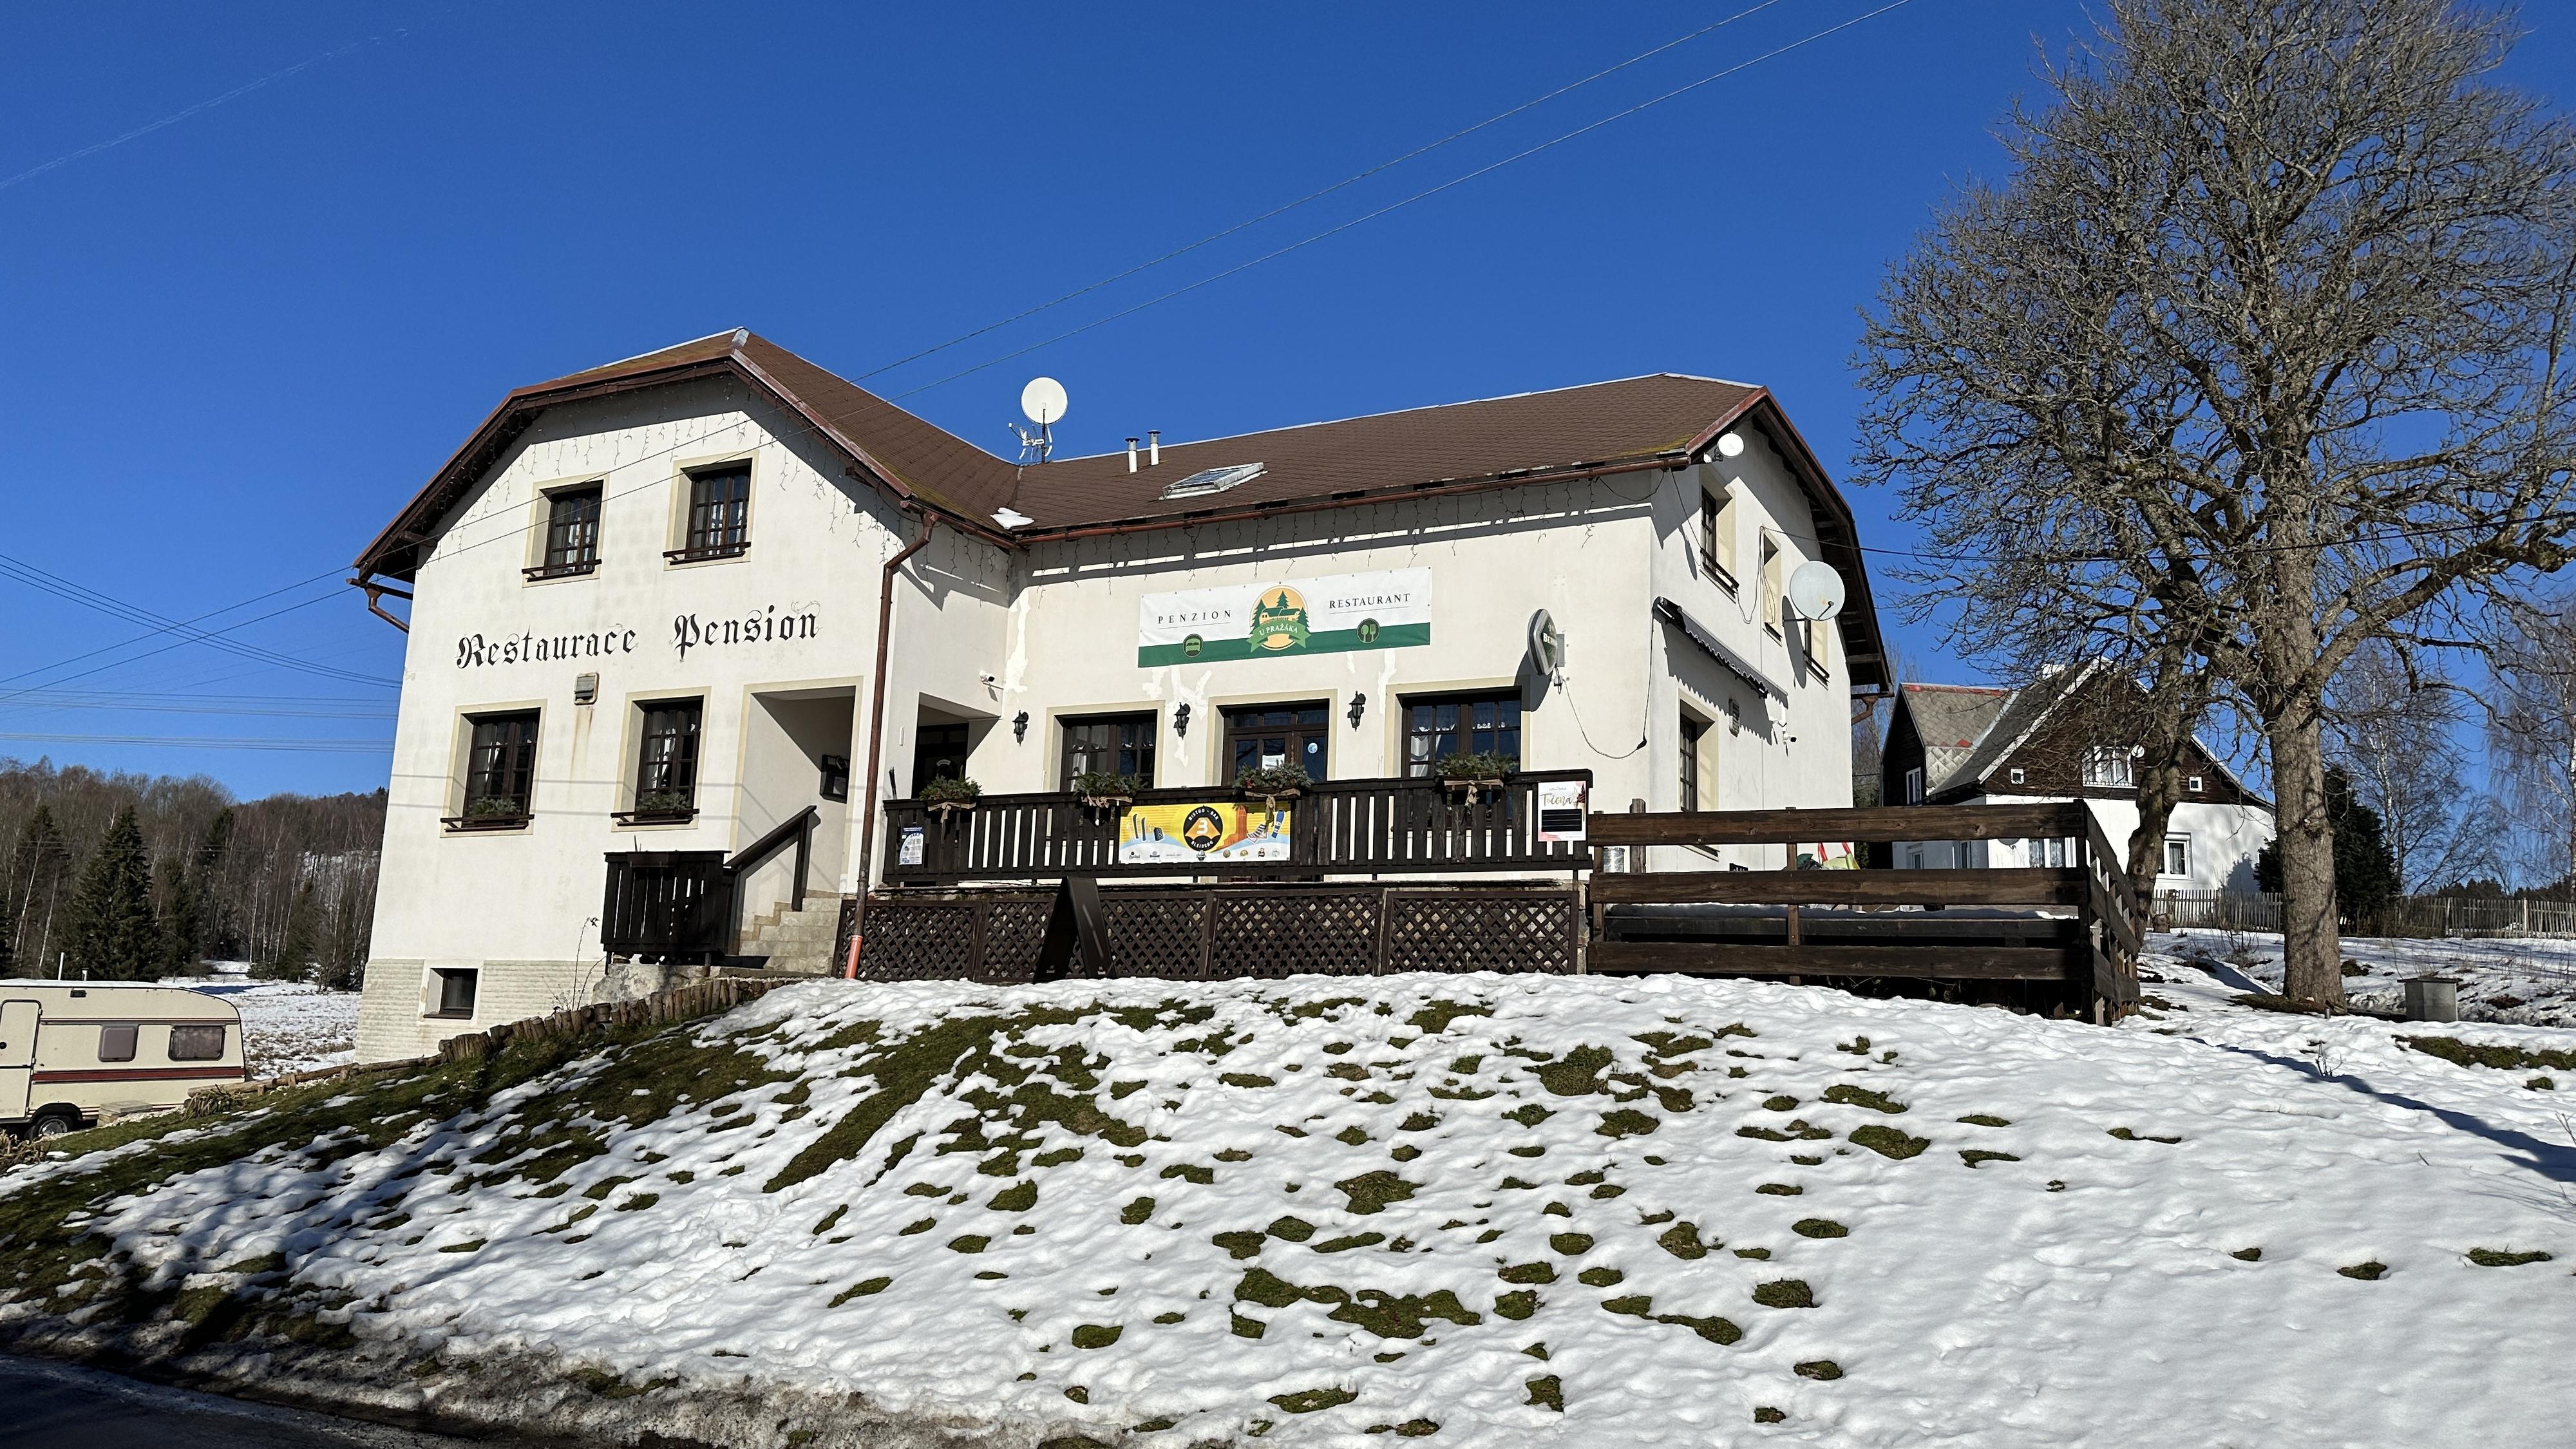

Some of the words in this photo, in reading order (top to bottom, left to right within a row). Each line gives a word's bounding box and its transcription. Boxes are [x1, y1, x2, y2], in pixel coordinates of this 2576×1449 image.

[1329, 593, 1410, 609] RESTAURANT
[1158, 610, 1231, 624] PENZION
[455, 623, 639, 668] Restaurace
[670, 601, 822, 662] Pension
[1265, 623, 1298, 634] PRAŽÁKA
[1188, 808, 1205, 820] BISTRO
[1210, 811, 1219, 820] BAR
